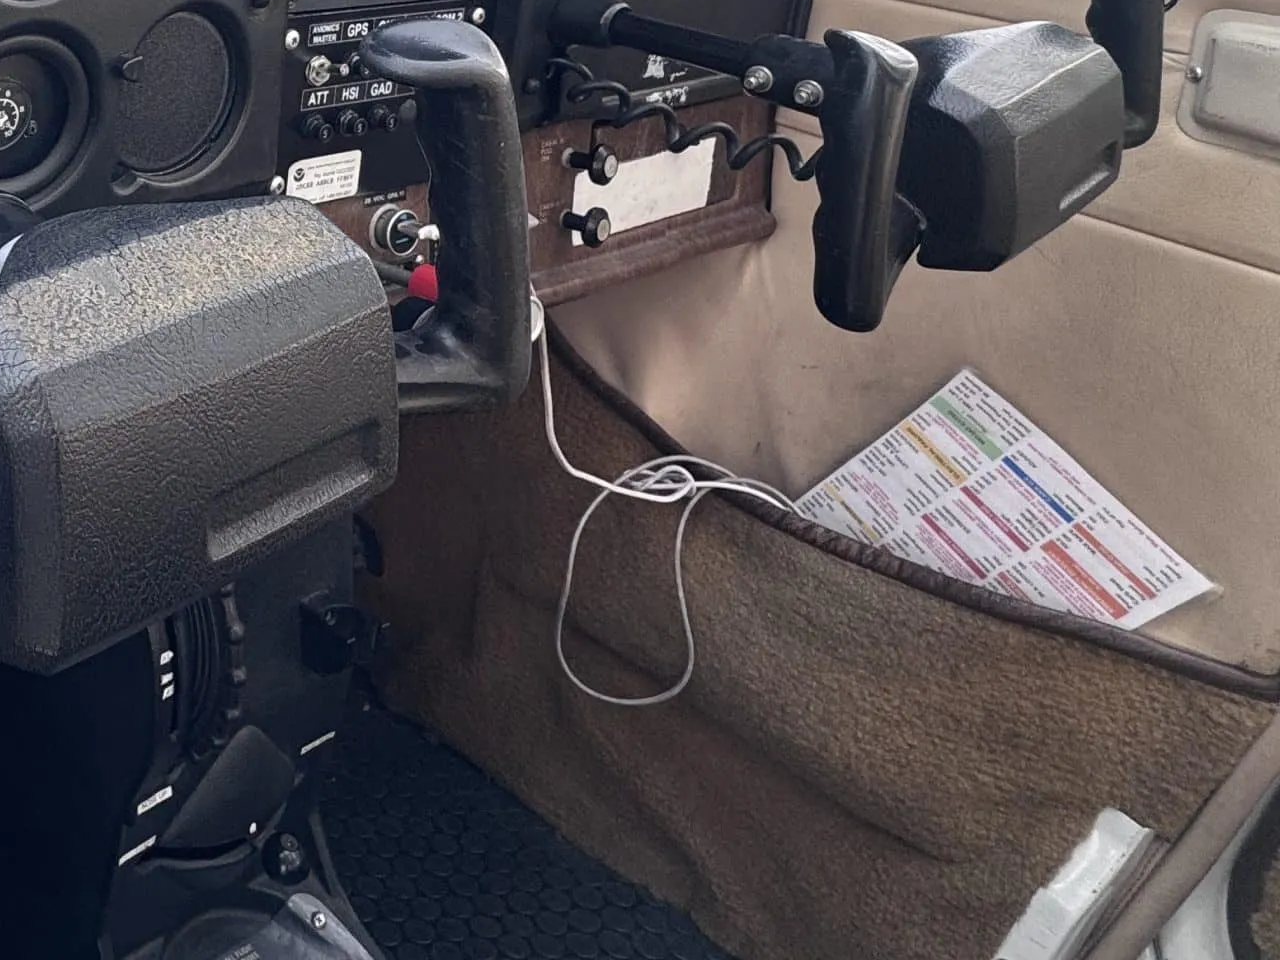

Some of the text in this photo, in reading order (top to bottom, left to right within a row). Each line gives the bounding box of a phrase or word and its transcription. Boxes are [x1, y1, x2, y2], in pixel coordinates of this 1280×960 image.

[312, 24, 340, 33] AVIONICS
[347, 22, 369, 37] GPS
[342, 86, 360, 101] HSI
[370, 81, 393, 96] GAD
[308, 91, 330, 106] ATT
